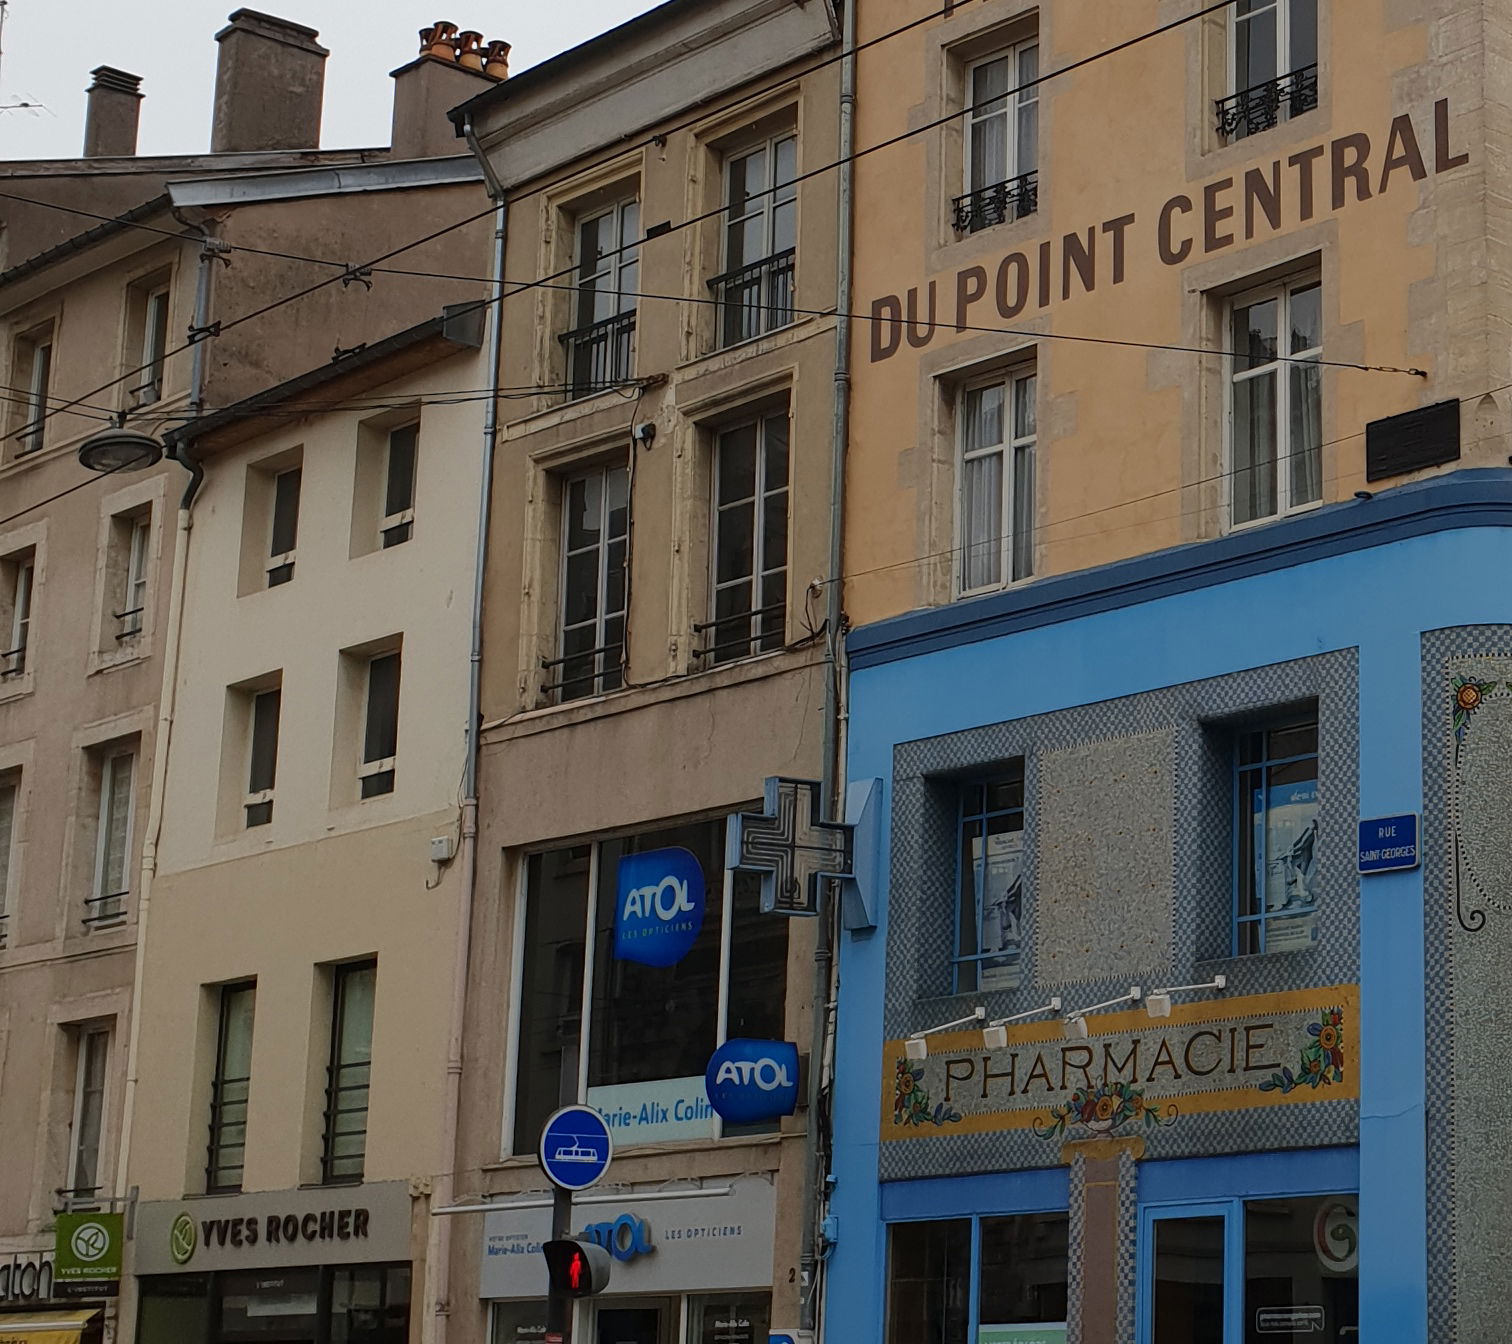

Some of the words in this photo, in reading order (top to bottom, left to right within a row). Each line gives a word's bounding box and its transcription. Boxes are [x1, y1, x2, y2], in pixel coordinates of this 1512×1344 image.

[870, 280, 938, 364] DU
[955, 213, 1136, 334] POINT
[1157, 97, 1471, 267] CENTRAL
[1378, 825, 1397, 839] RUE
[1360, 845, 1416, 863] SAINT-GEORGES
[623, 875, 696, 921] ATOL
[716, 1057, 794, 1091] ATOL
[944, 1023, 1282, 1103] PHARMACIE
[600, 1105, 669, 1128] arie-Alix
[202, 1218, 258, 1247] YVES
[266, 1208, 370, 1242] ROCHER
[665, 1229, 682, 1240] LES
[686, 1226, 742, 1238] OPTICIENS
[527, 1241, 545, 1254] Coli
[788, 1268, 796, 1284] 2
